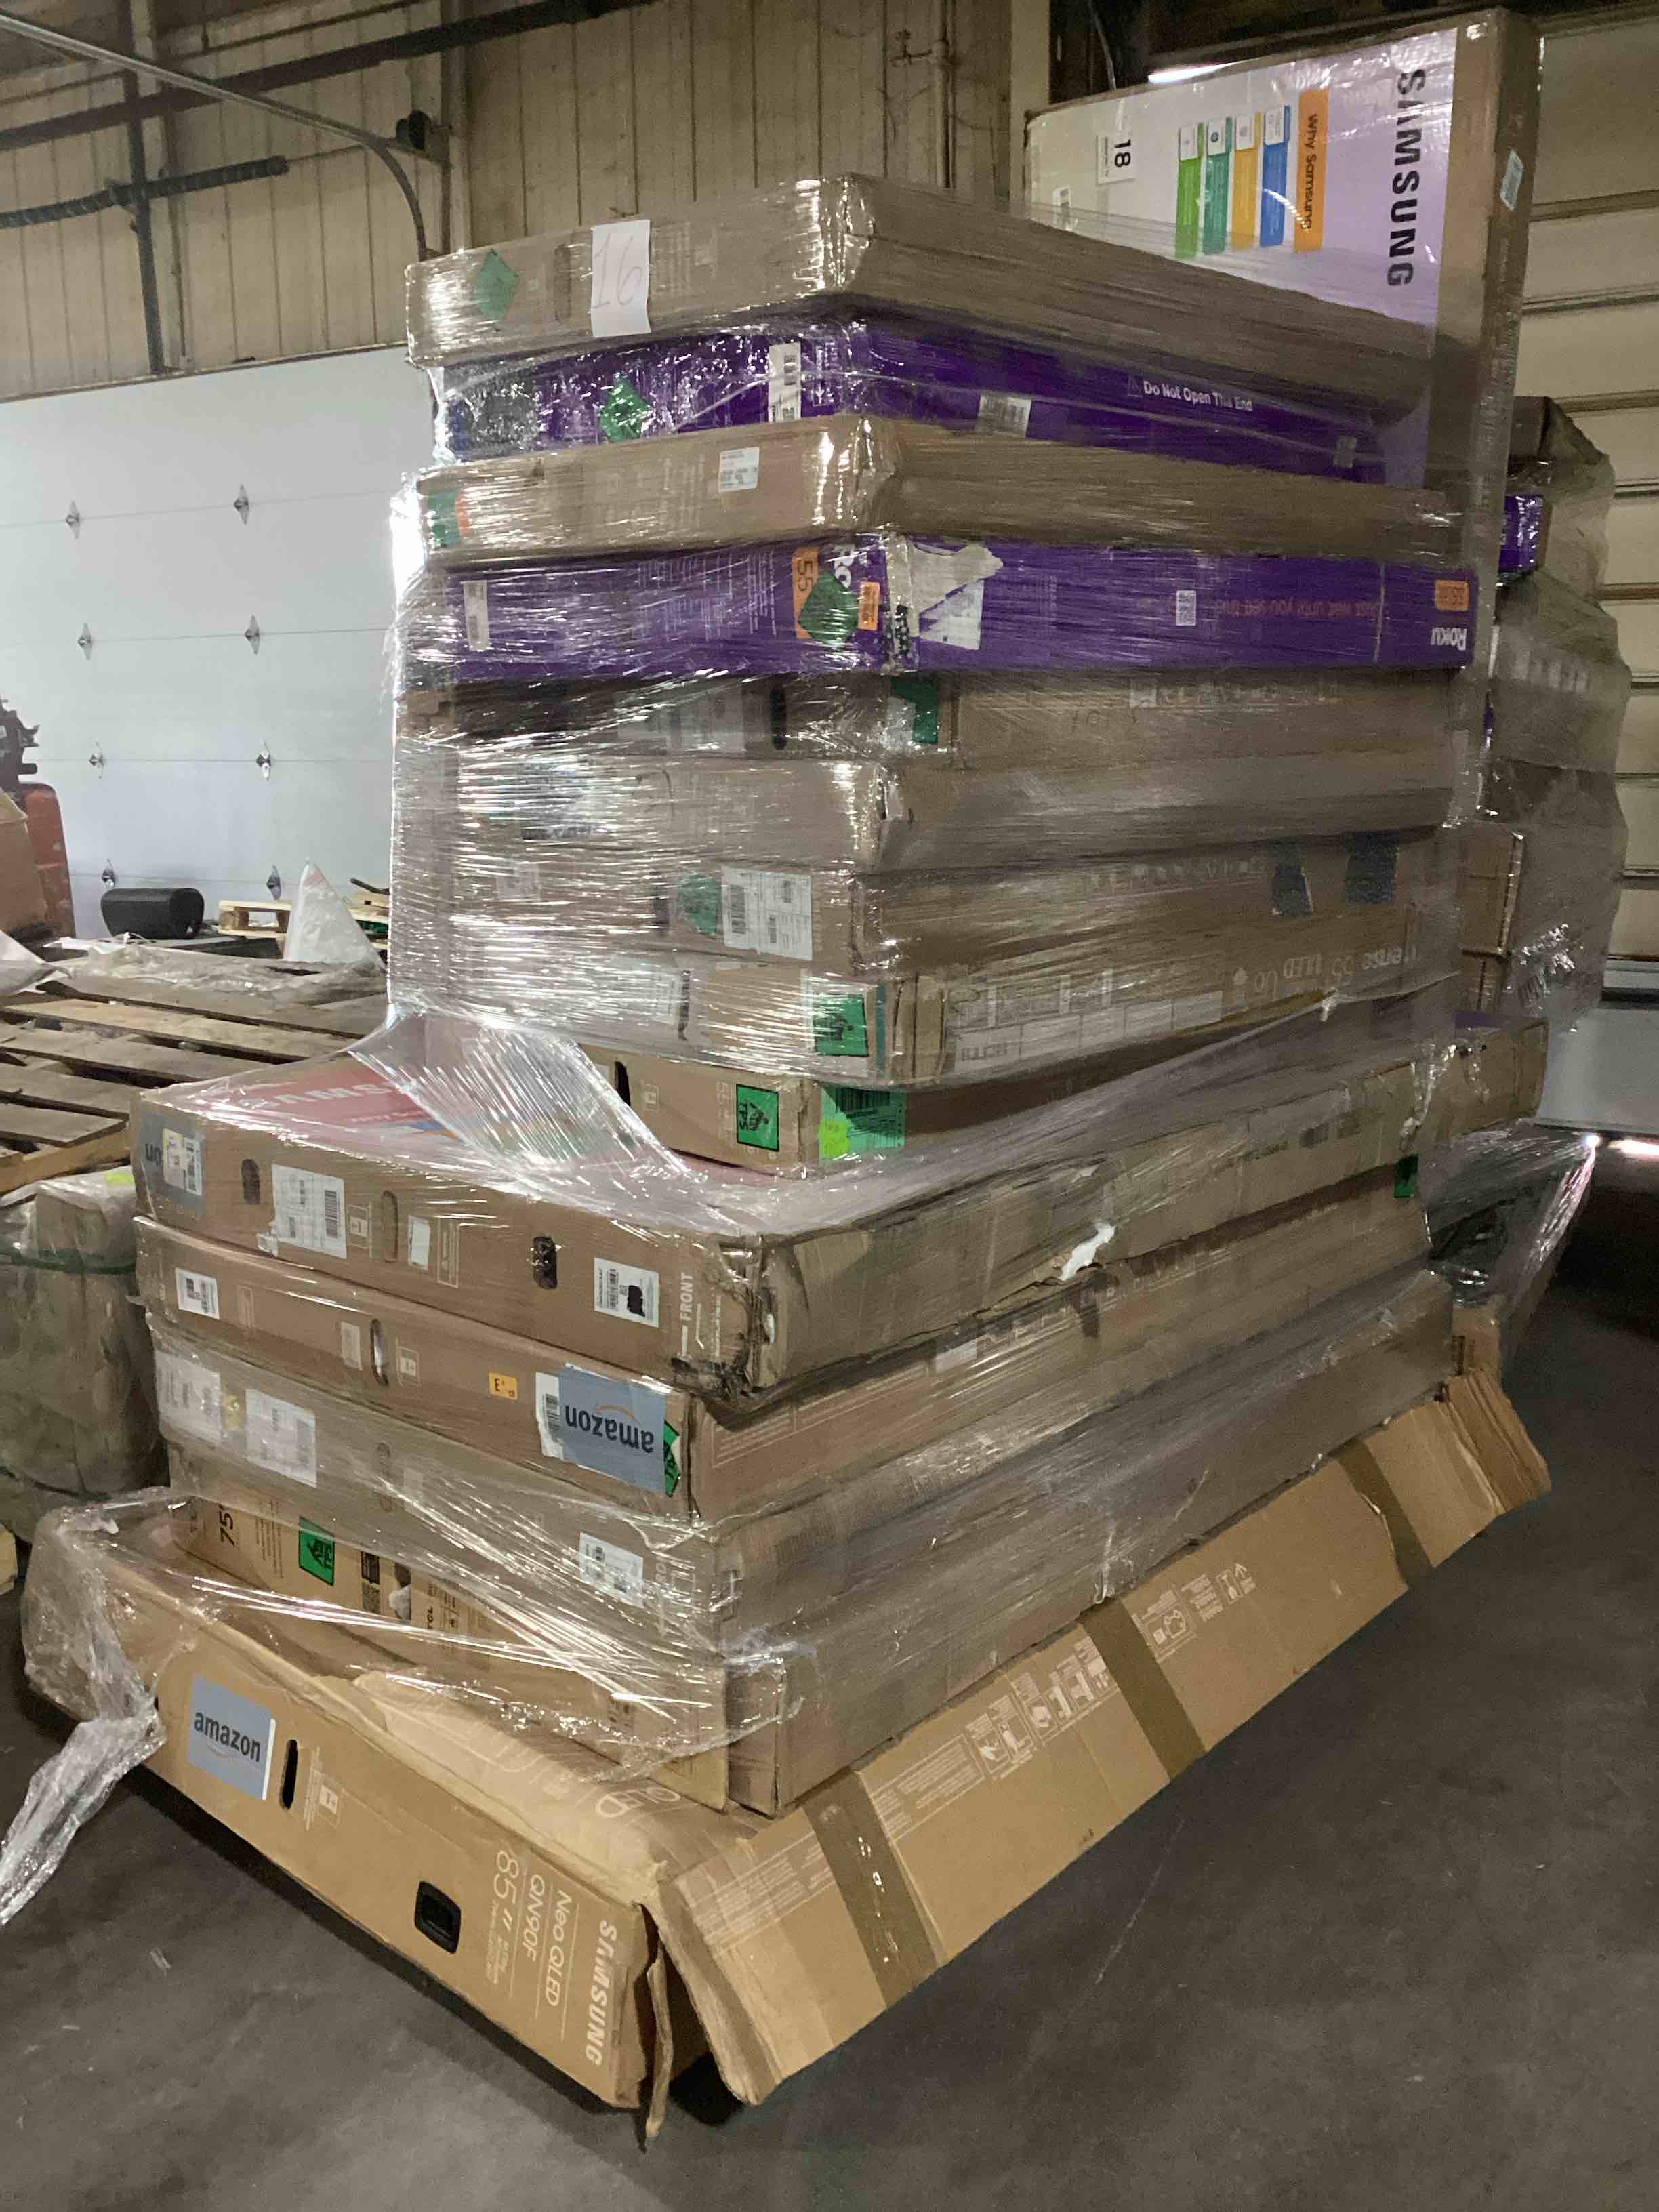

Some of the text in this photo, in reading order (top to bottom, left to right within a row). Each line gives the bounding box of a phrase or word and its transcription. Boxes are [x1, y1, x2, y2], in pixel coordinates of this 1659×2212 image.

[1113, 139, 1132, 168] 18
[1300, 113, 1318, 231] Why Samsung
[1387, 69, 1426, 287] SAMSUNG
[593, 230, 644, 310] 16
[1143, 380, 1160, 395] Do
[1162, 383, 1181, 399] Not
[1183, 387, 1212, 405] Open
[1234, 396, 1253, 411] End
[798, 560, 814, 592] 55
[739, 1101, 749, 1132] TPS
[680, 1271, 693, 1322] FRONT
[565, 1404, 655, 1454] amazon
[194, 1711, 261, 1763] amazon
[523, 1874, 546, 1963] QN90F
[546, 1889, 573, 2007] Neo QLED
[585, 1919, 618, 2066] SAMSUNG
